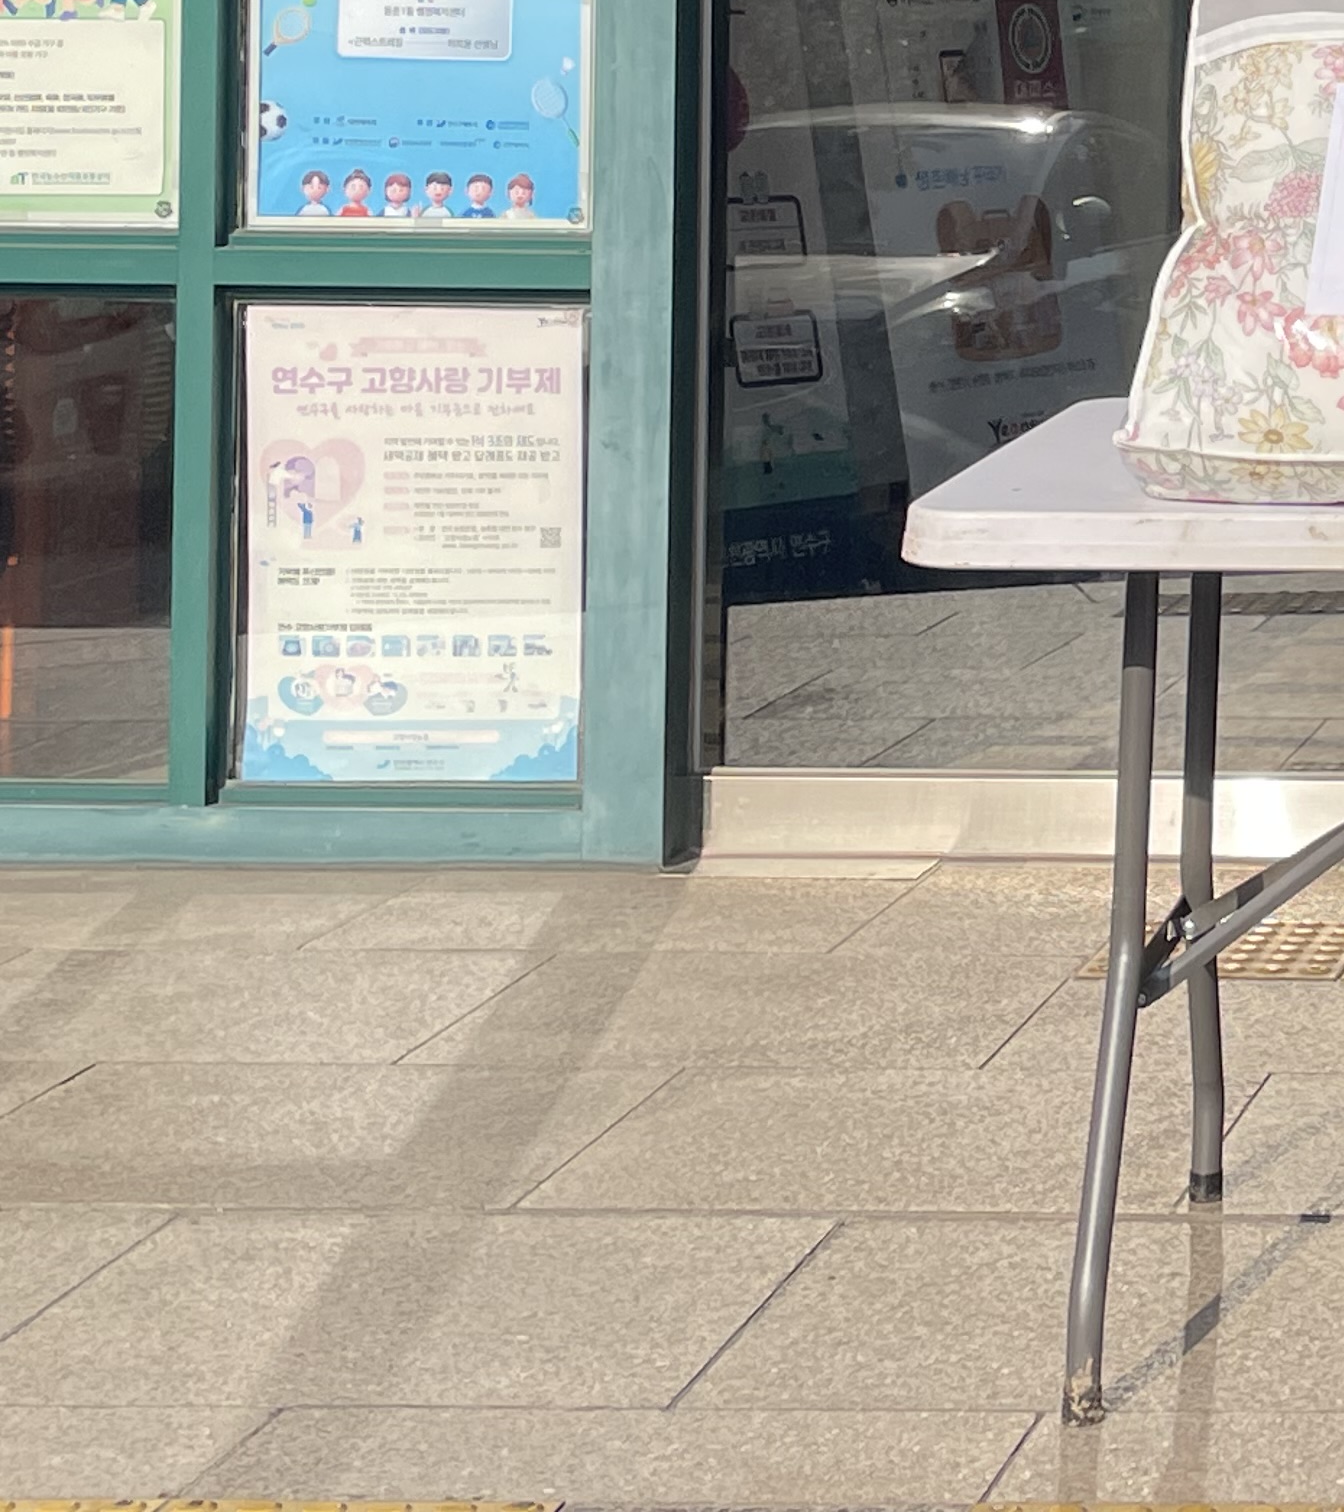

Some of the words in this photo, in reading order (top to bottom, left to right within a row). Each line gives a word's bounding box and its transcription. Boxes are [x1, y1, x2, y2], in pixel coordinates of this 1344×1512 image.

[271, 366, 354, 395] 연수구
[360, 366, 471, 395] 고향사랑
[477, 366, 562, 395] 기부제
